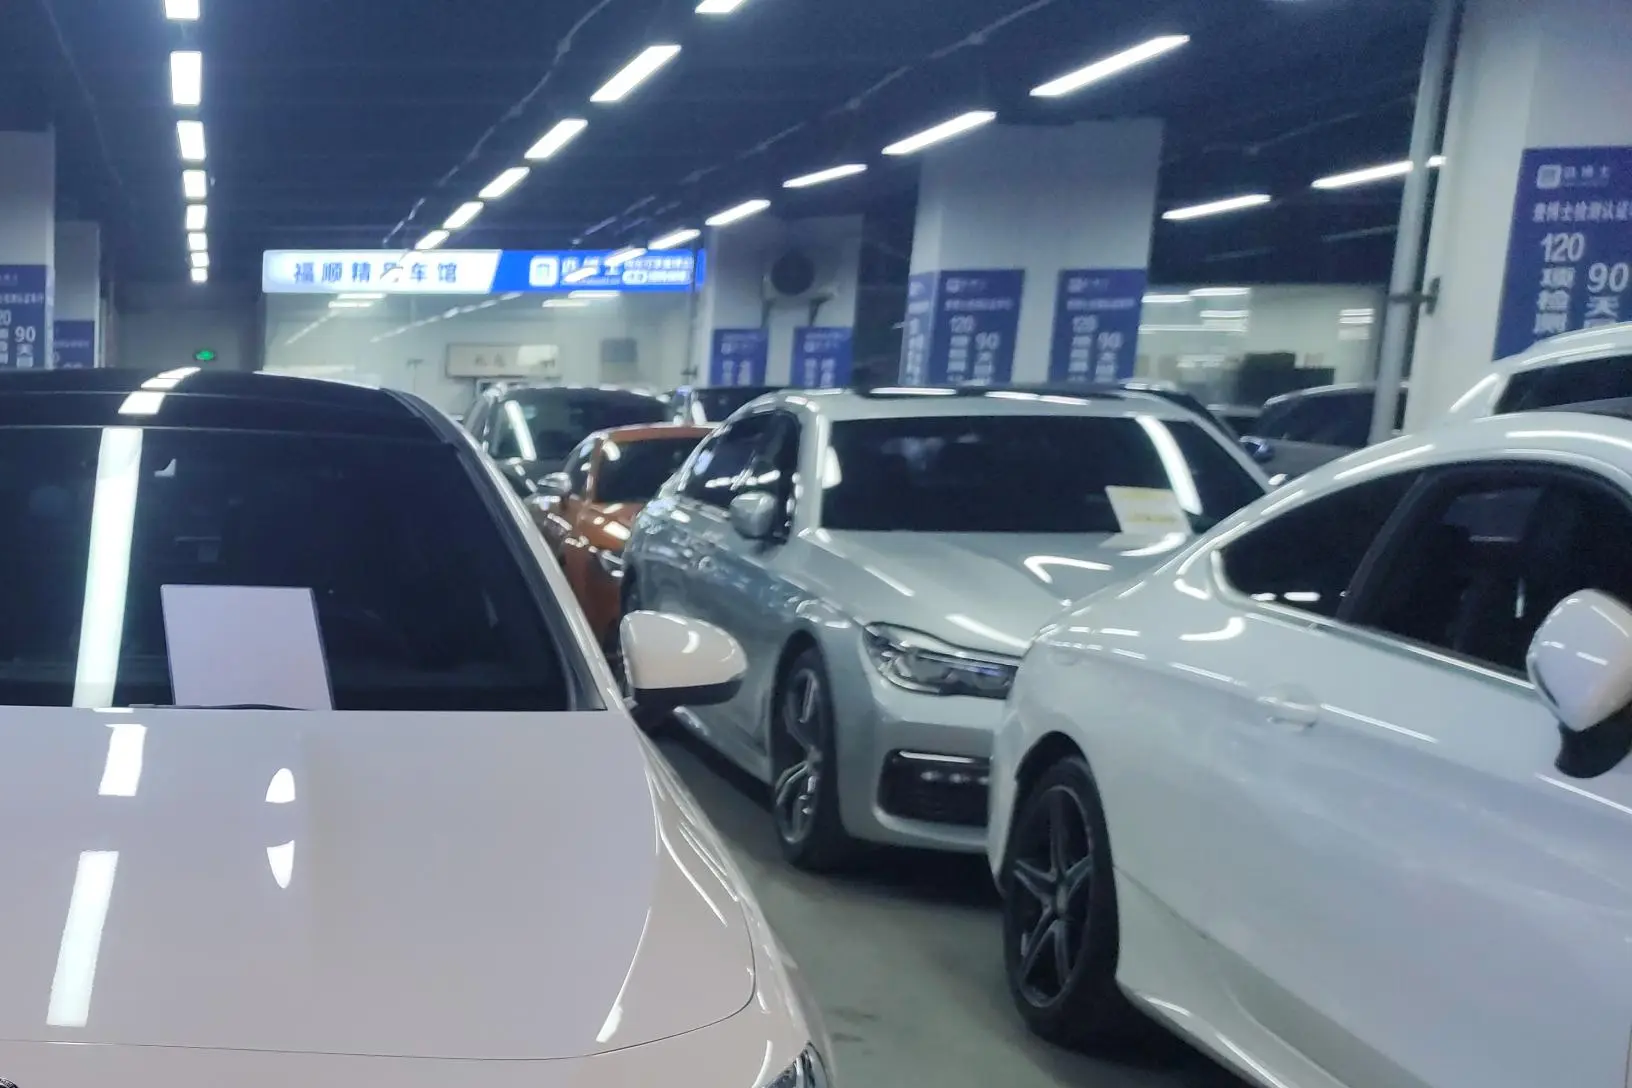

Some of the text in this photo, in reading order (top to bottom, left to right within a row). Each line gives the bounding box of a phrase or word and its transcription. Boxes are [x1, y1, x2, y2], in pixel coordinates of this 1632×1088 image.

[1540, 232, 1585, 263] 120
[1587, 262, 1629, 293] 90
[15, 326, 36, 342] 90
